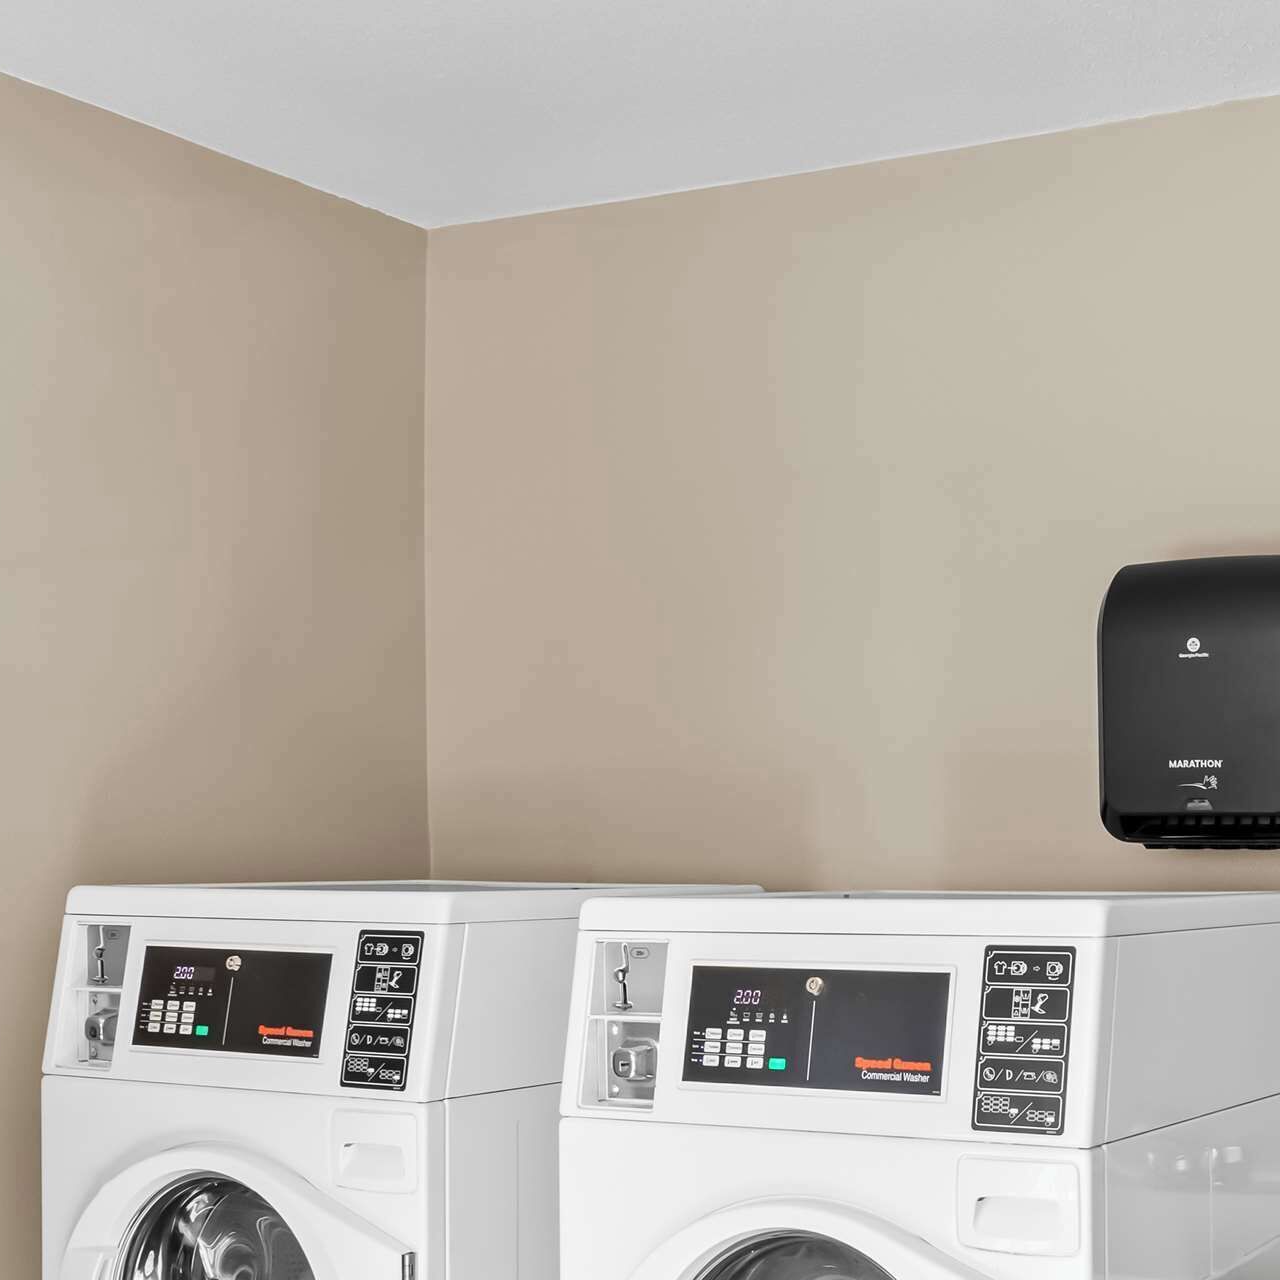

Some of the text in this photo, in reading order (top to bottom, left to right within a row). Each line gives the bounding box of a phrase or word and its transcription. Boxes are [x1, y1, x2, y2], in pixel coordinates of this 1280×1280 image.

[1168, 759, 1222, 768] MARATHON
[861, 1070, 930, 1083] Commercial Washer
